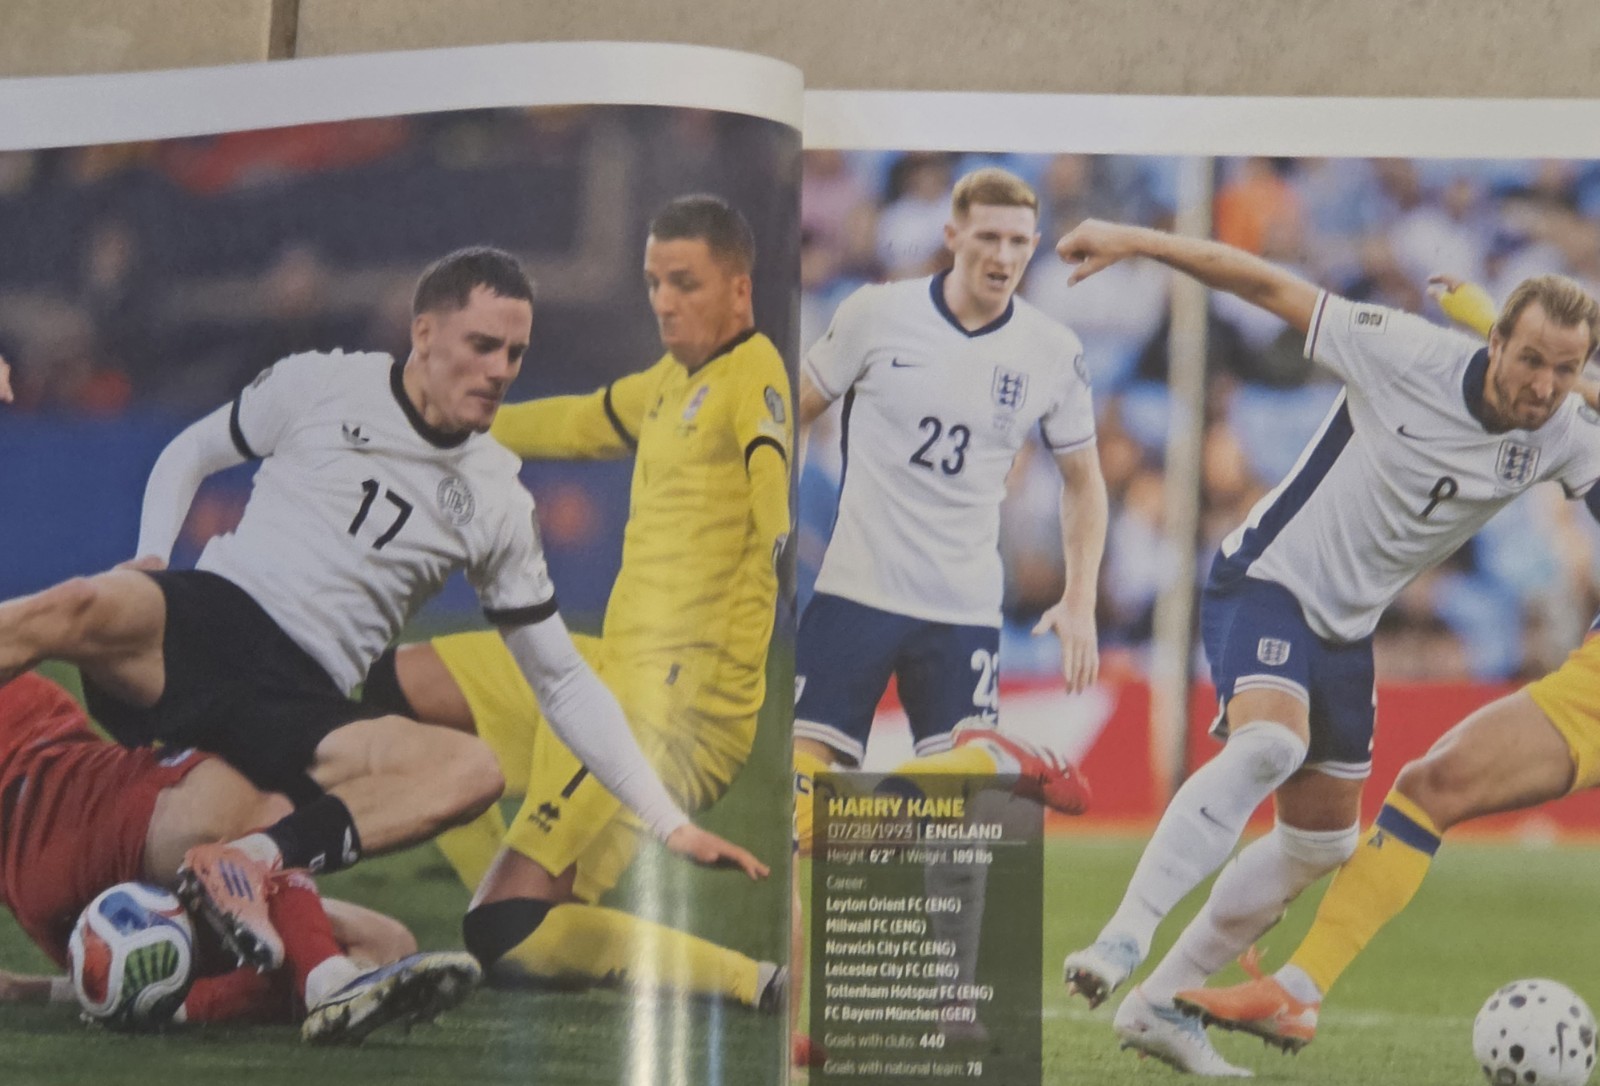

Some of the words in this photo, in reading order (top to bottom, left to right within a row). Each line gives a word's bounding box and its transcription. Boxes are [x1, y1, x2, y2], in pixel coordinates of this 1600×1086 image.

[909, 416, 970, 475] 23
[1419, 476, 1458, 519] 9
[348, 479, 413, 550] 17
[828, 798, 903, 817] HARRY
[907, 798, 966, 817] KANE
[828, 823, 914, 840] 07/28/1993
[925, 823, 1003, 840] ENGLAND
[952, 849, 973, 864] 189
[974, 849, 993, 864] lbs
[826, 896, 867, 913] Leyton
[868, 896, 906, 912] Orient
[908, 897, 922, 912] FC
[924, 896, 962, 913] (ENG)
[826, 918, 872, 934] Millwall
[873, 918, 888, 934] FC
[890, 918, 927, 935] (ENG)
[825, 940, 875, 955] Norwich
[877, 940, 901, 957] City
[902, 941, 917, 955] FC
[919, 940, 956, 957] (ENG)
[825, 962, 878, 977] Leicester
[880, 962, 904, 980] City
[905, 963, 920, 977] FC
[922, 962, 960, 979] (ENG)
[825, 984, 889, 999] Tottenham
[890, 984, 939, 1001] Hotspur
[939, 984, 955, 999] FC
[956, 984, 994, 1001] (ENG)
[824, 1006, 840, 1020] FC
[841, 1006, 884, 1023] Bayern
[885, 1004, 939, 1021] München
[940, 1006, 977, 1023] (GER)
[824, 1033, 856, 1048] Goals
[858, 1033, 883, 1048] with
[919, 1033, 946, 1048] 440
[823, 1060, 856, 1076] Goals
[858, 1060, 883, 1076] with
[885, 1061, 931, 1076] national
[967, 1061, 983, 1077] 78
